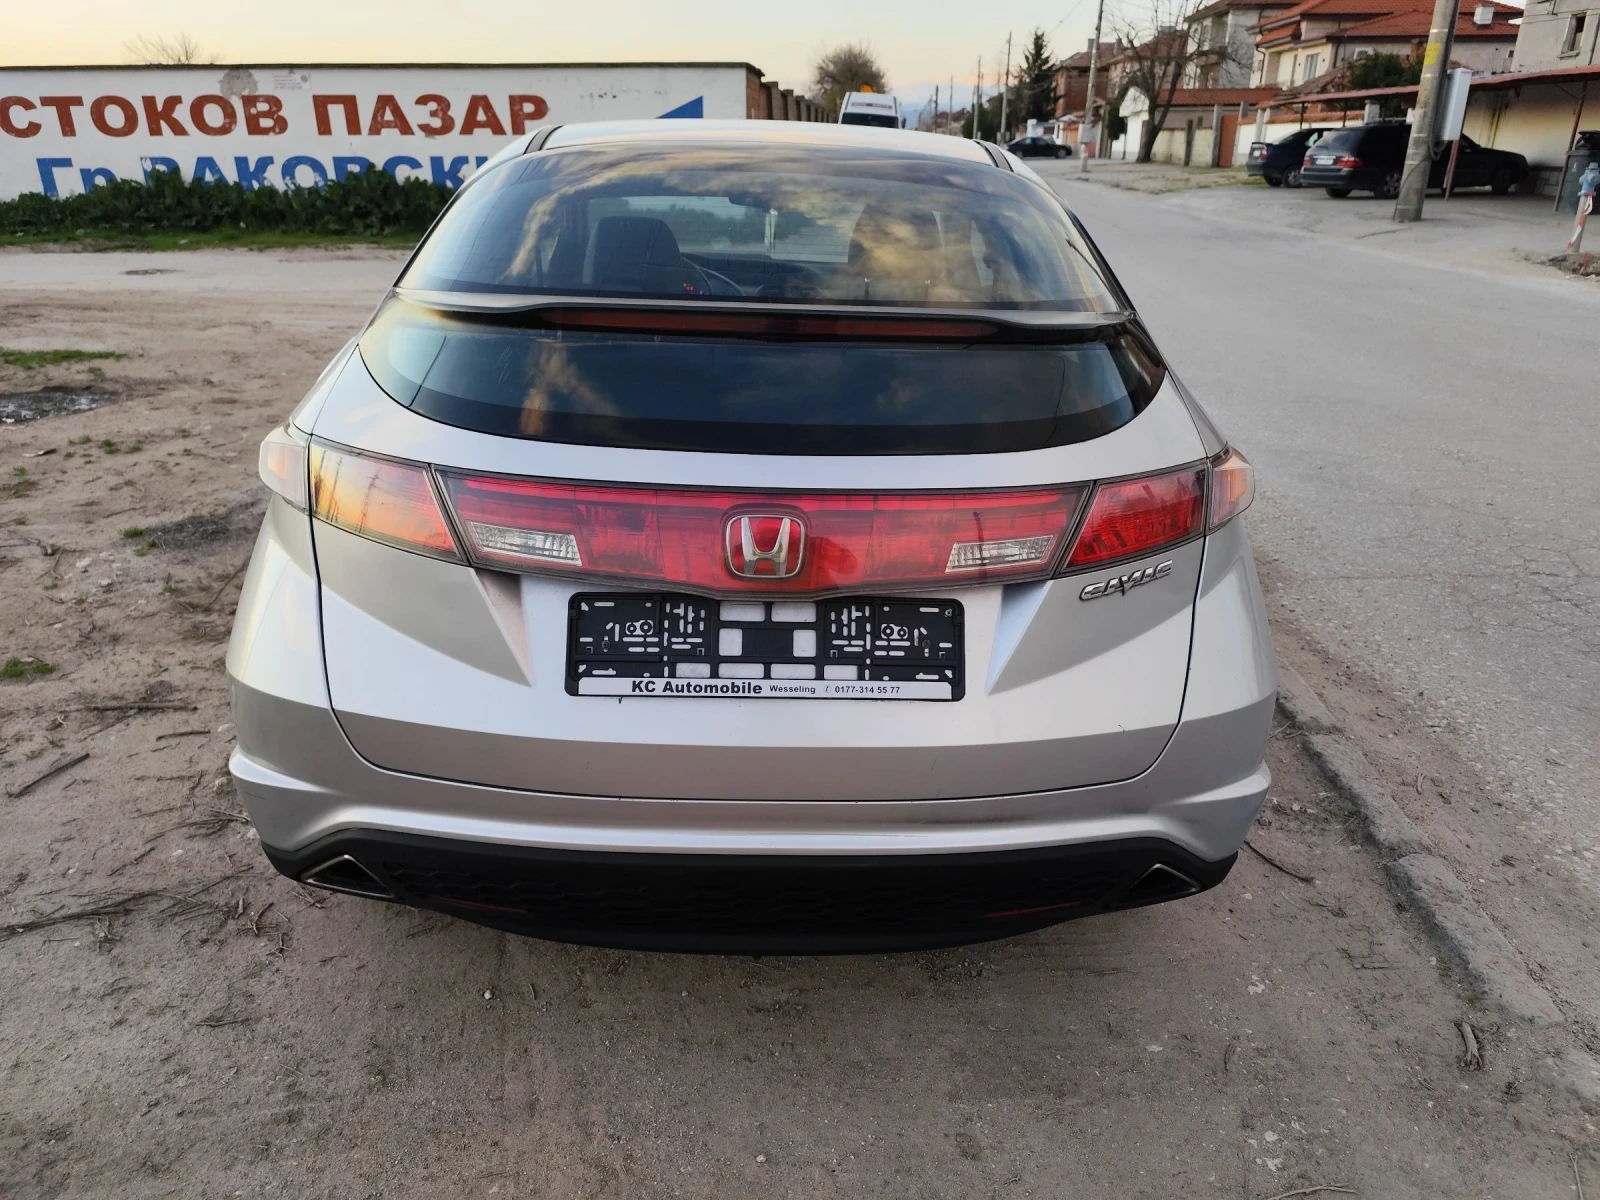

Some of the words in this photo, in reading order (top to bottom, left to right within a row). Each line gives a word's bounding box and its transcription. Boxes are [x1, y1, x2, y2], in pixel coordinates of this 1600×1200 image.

[312, 94, 549, 137] ПАЗАР
[631, 680, 656, 693] KC
[662, 680, 763, 694] Automobile
[769, 684, 816, 694] Wesseling
[834, 685, 874, 694] 0177-314
[877, 686, 888, 694] 55
[890, 686, 901, 694] 77
